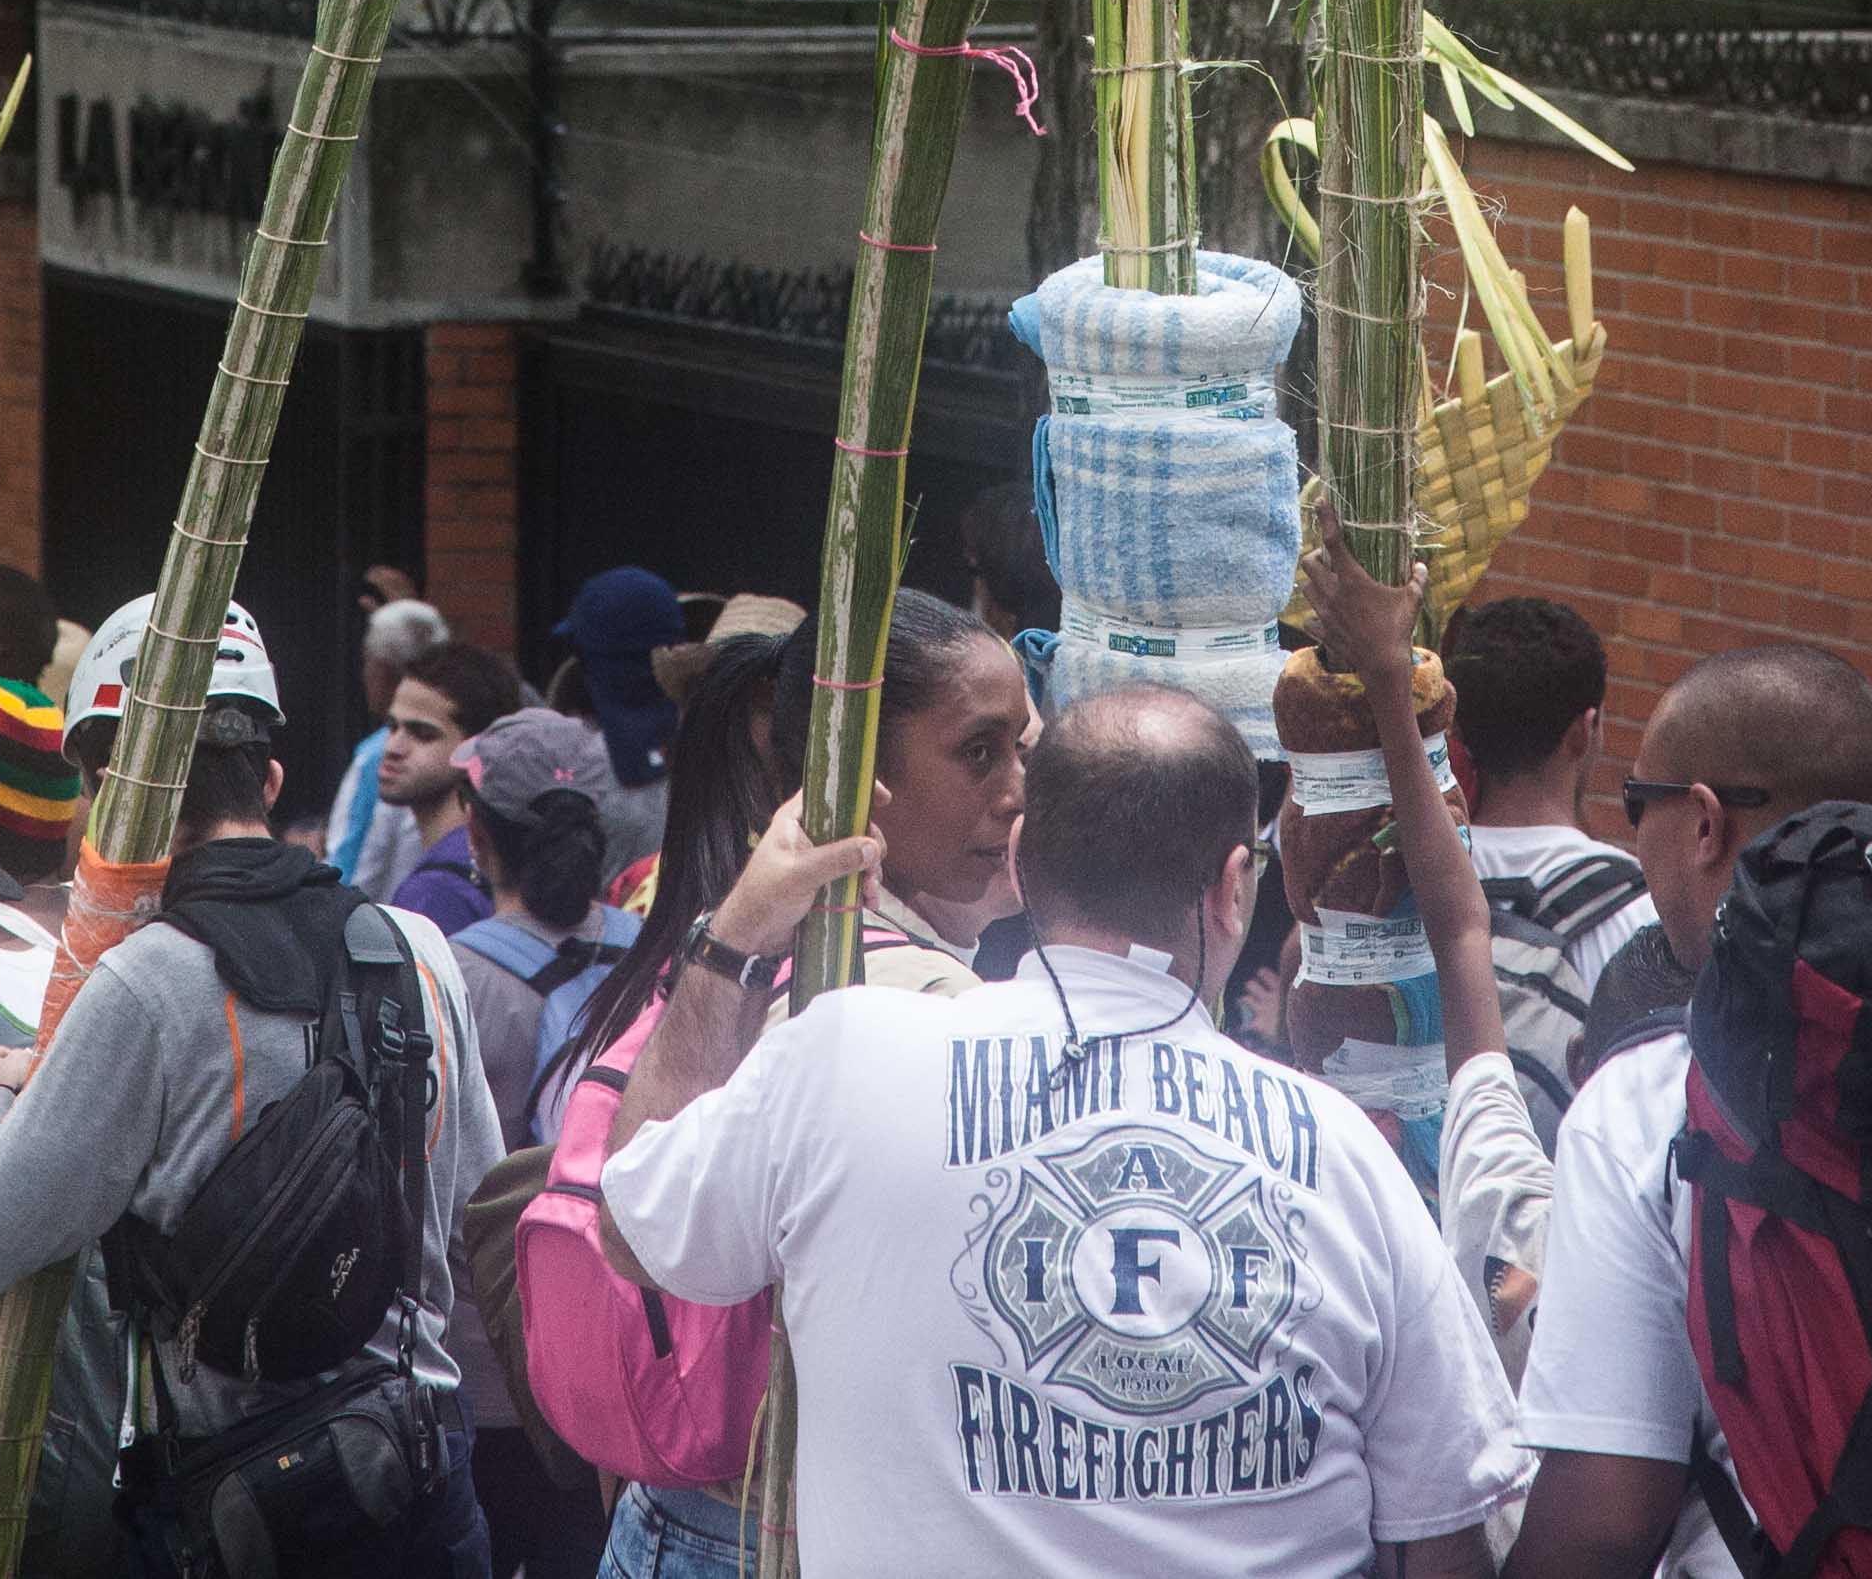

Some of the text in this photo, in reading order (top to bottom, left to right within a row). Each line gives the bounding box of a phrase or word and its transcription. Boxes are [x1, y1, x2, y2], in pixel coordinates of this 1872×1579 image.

[946, 1035, 1321, 1194] MIAMI BEACH
[1113, 1146, 1169, 1192] A
[1023, 1228, 1270, 1316] I F F
[1099, 1354, 1191, 1373] LOCAL
[952, 1363, 1322, 1503] FIREFIGHTERS
